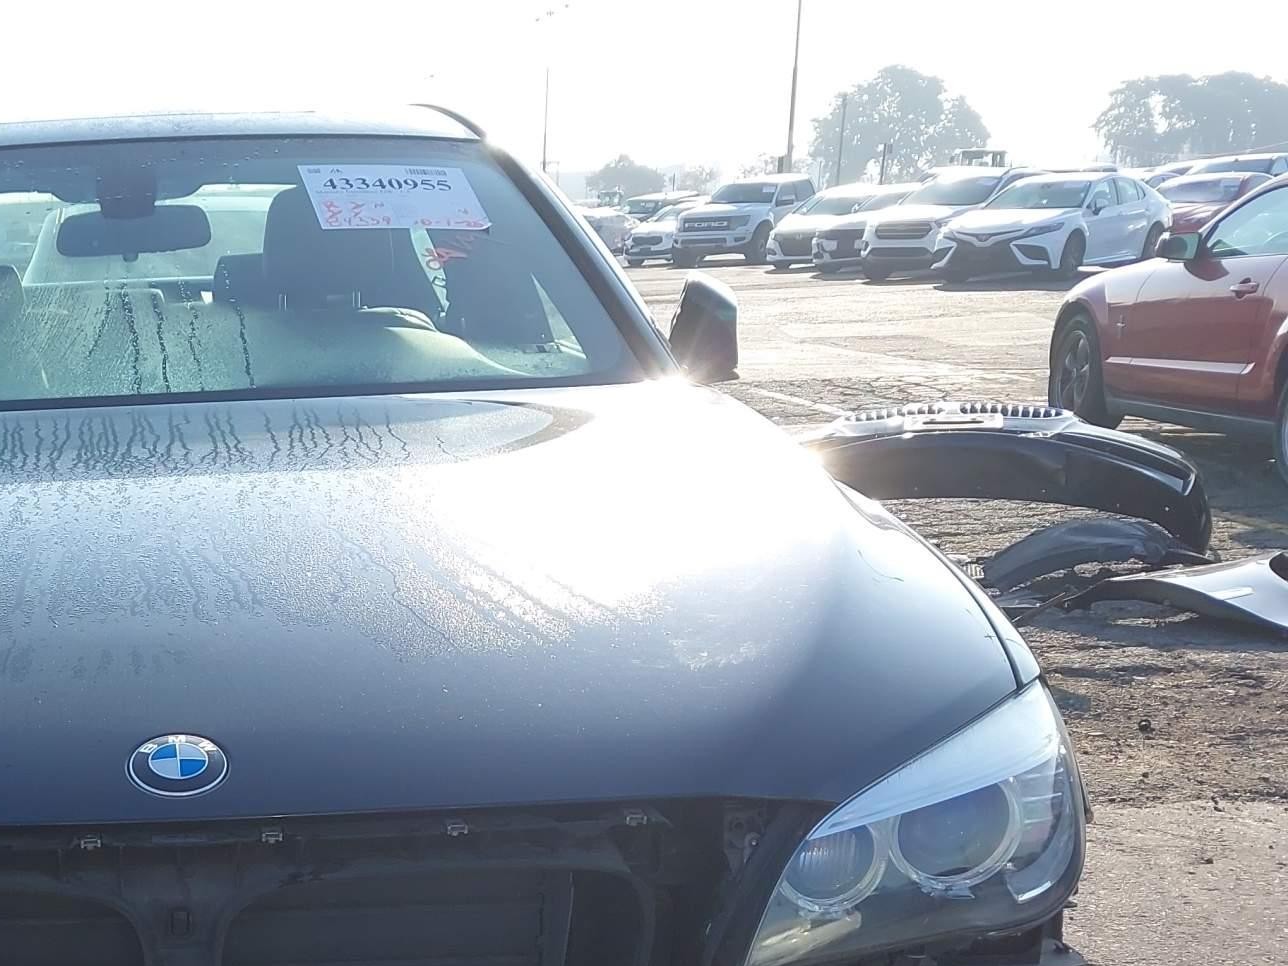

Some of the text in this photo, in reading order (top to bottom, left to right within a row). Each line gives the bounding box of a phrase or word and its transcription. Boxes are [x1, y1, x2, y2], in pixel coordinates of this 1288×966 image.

[323, 177, 452, 191] 43340955
[685, 220, 728, 228] FORD
[138, 734, 217, 754] BMW
